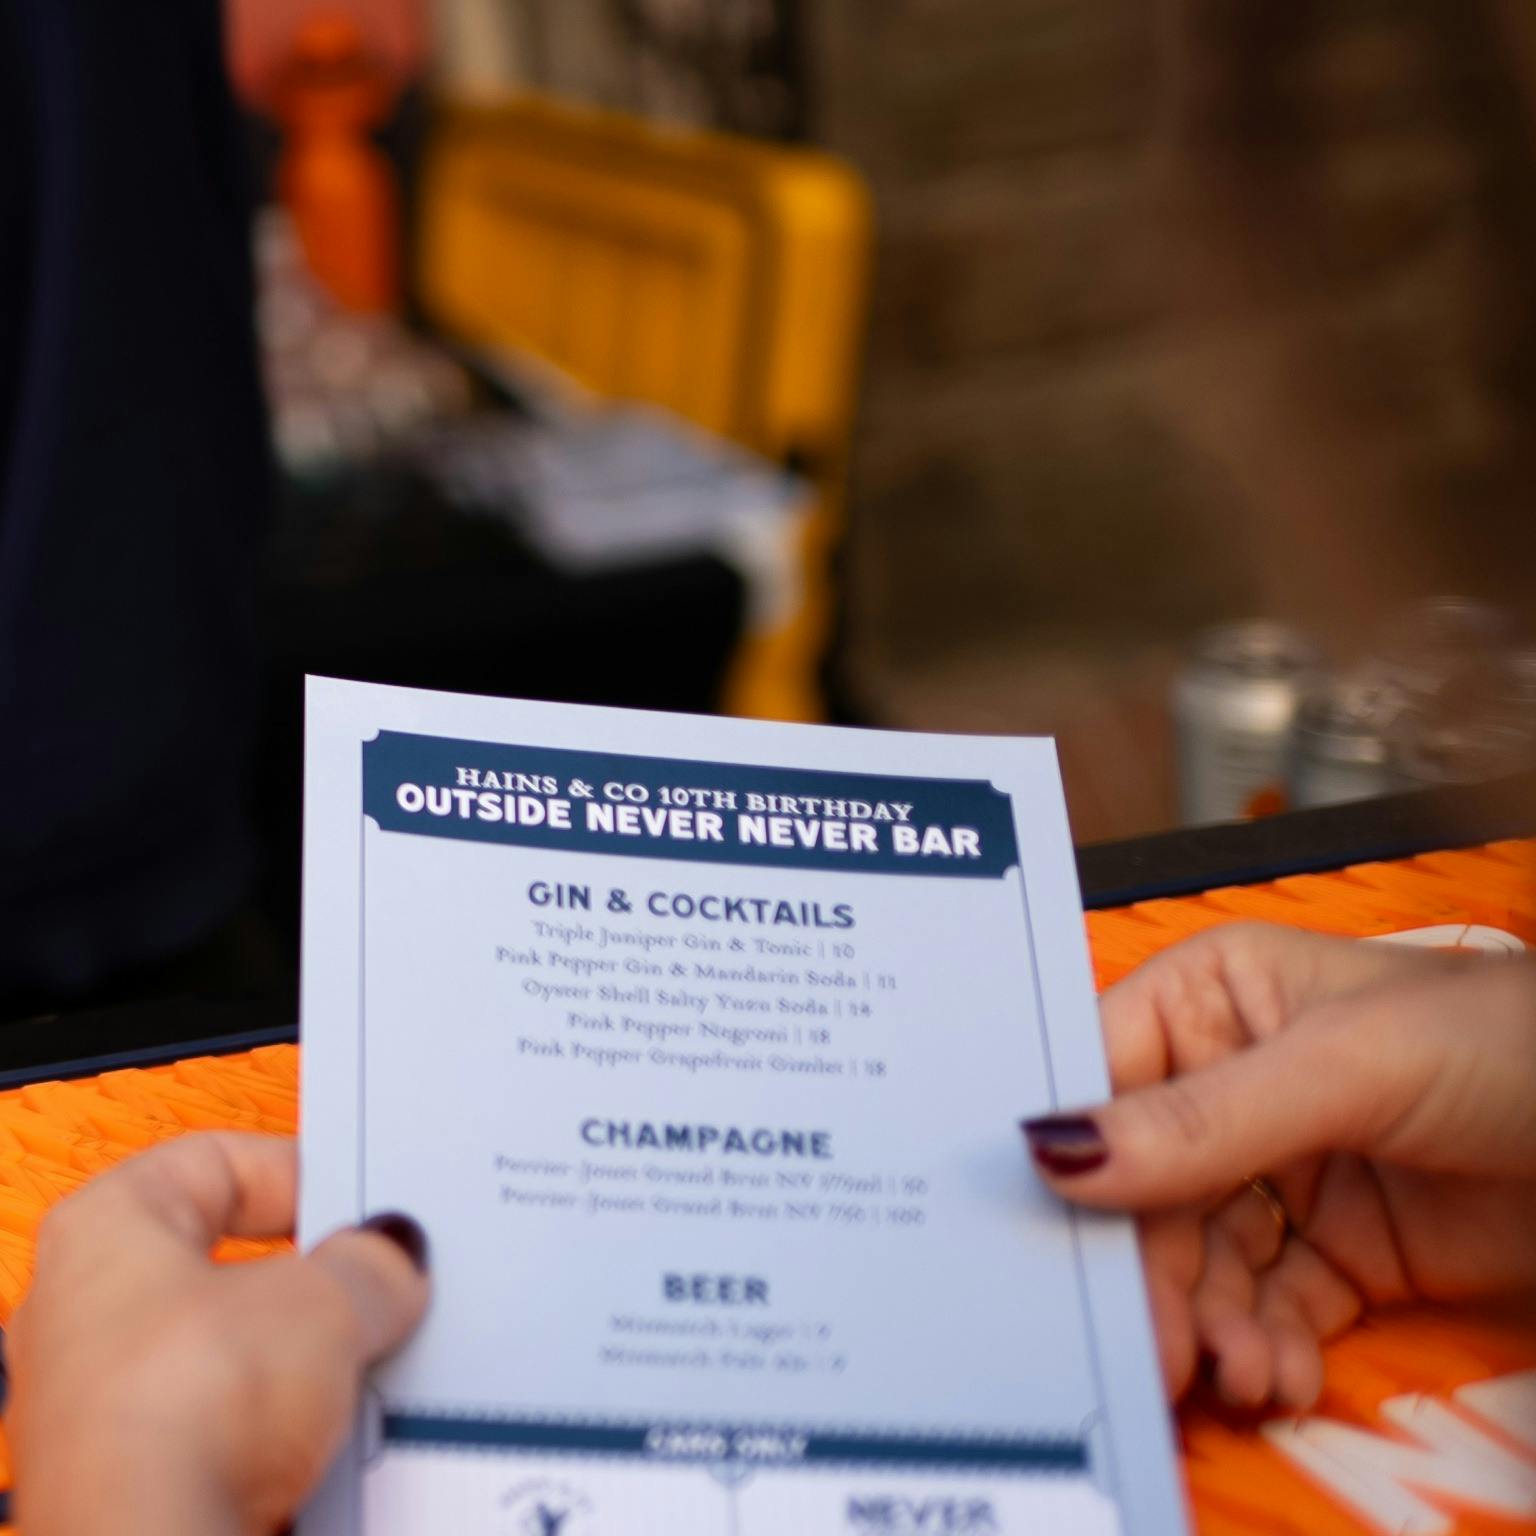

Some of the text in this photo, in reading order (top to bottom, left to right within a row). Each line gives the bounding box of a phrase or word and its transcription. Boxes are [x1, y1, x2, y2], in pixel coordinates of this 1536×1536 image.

[455, 767, 914, 821] HAINS & CO 10TH BIRTHDAY
[395, 783, 982, 856] OUTSIDE NEVER NEVER BAR
[527, 881, 856, 929] GIN & COCKTAILS
[532, 920, 594, 946] Triple
[598, 926, 677, 952] Juniper
[684, 933, 722, 951] Gin
[729, 938, 745, 952] &
[753, 938, 812, 957] Tonic
[832, 944, 856, 959] 10
[496, 945, 542, 965] Pink
[548, 950, 618, 975] Pepper
[624, 958, 663, 975] Gin
[670, 963, 688, 977] &
[695, 963, 800, 984] Mandarin
[806, 970, 857, 988] Soda
[522, 977, 592, 1002] Oyster
[598, 984, 650, 1004] Shell
[778, 997, 828, 1015] Soda
[567, 1011, 614, 1031] Pink
[621, 1016, 692, 1041] Pepper
[697, 1021, 788, 1047] Negroni
[516, 1036, 565, 1057] Pink
[570, 1040, 641, 1068] Pepper
[647, 1047, 762, 1073] Grapefruit
[580, 1119, 832, 1158] CHAMPAGNE
[663, 1275, 768, 1304] BEER
